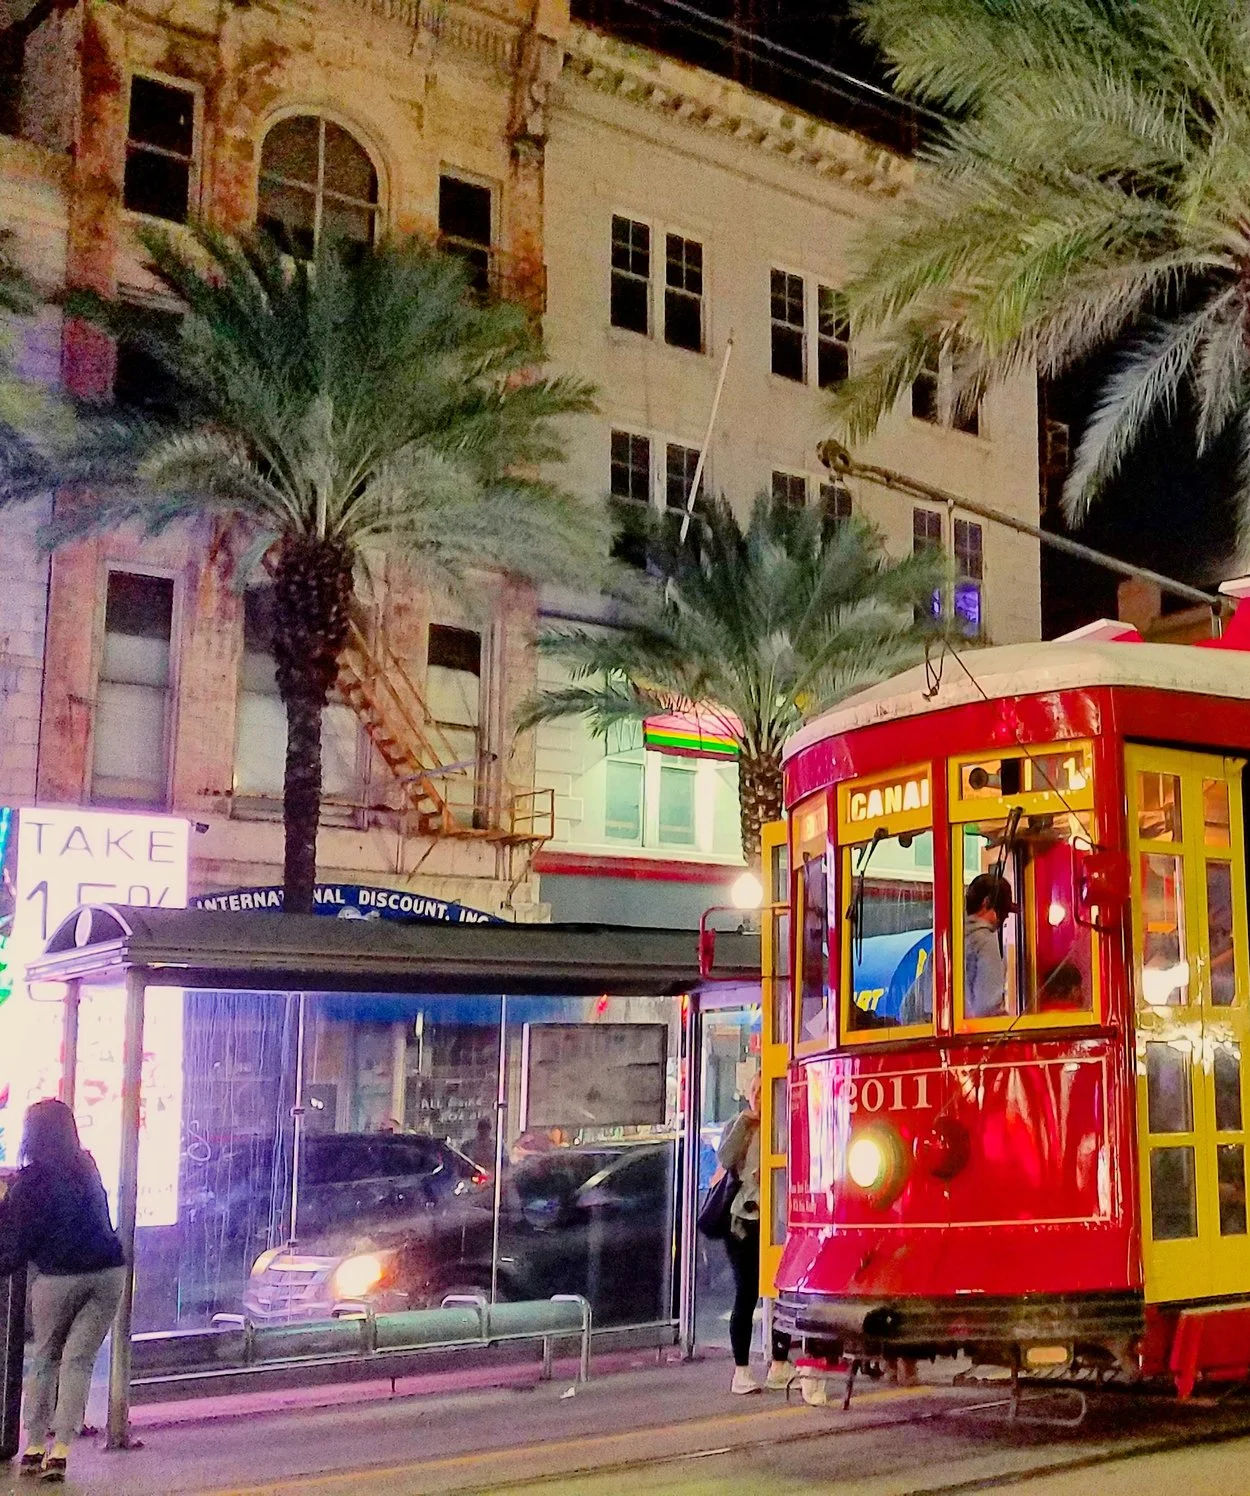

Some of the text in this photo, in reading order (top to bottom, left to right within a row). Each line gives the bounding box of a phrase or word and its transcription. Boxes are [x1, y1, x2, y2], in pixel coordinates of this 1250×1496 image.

[25, 821, 175, 863] TAKE
[197, 888, 345, 911] INTERNANAL
[842, 1074, 933, 1113] 2011
